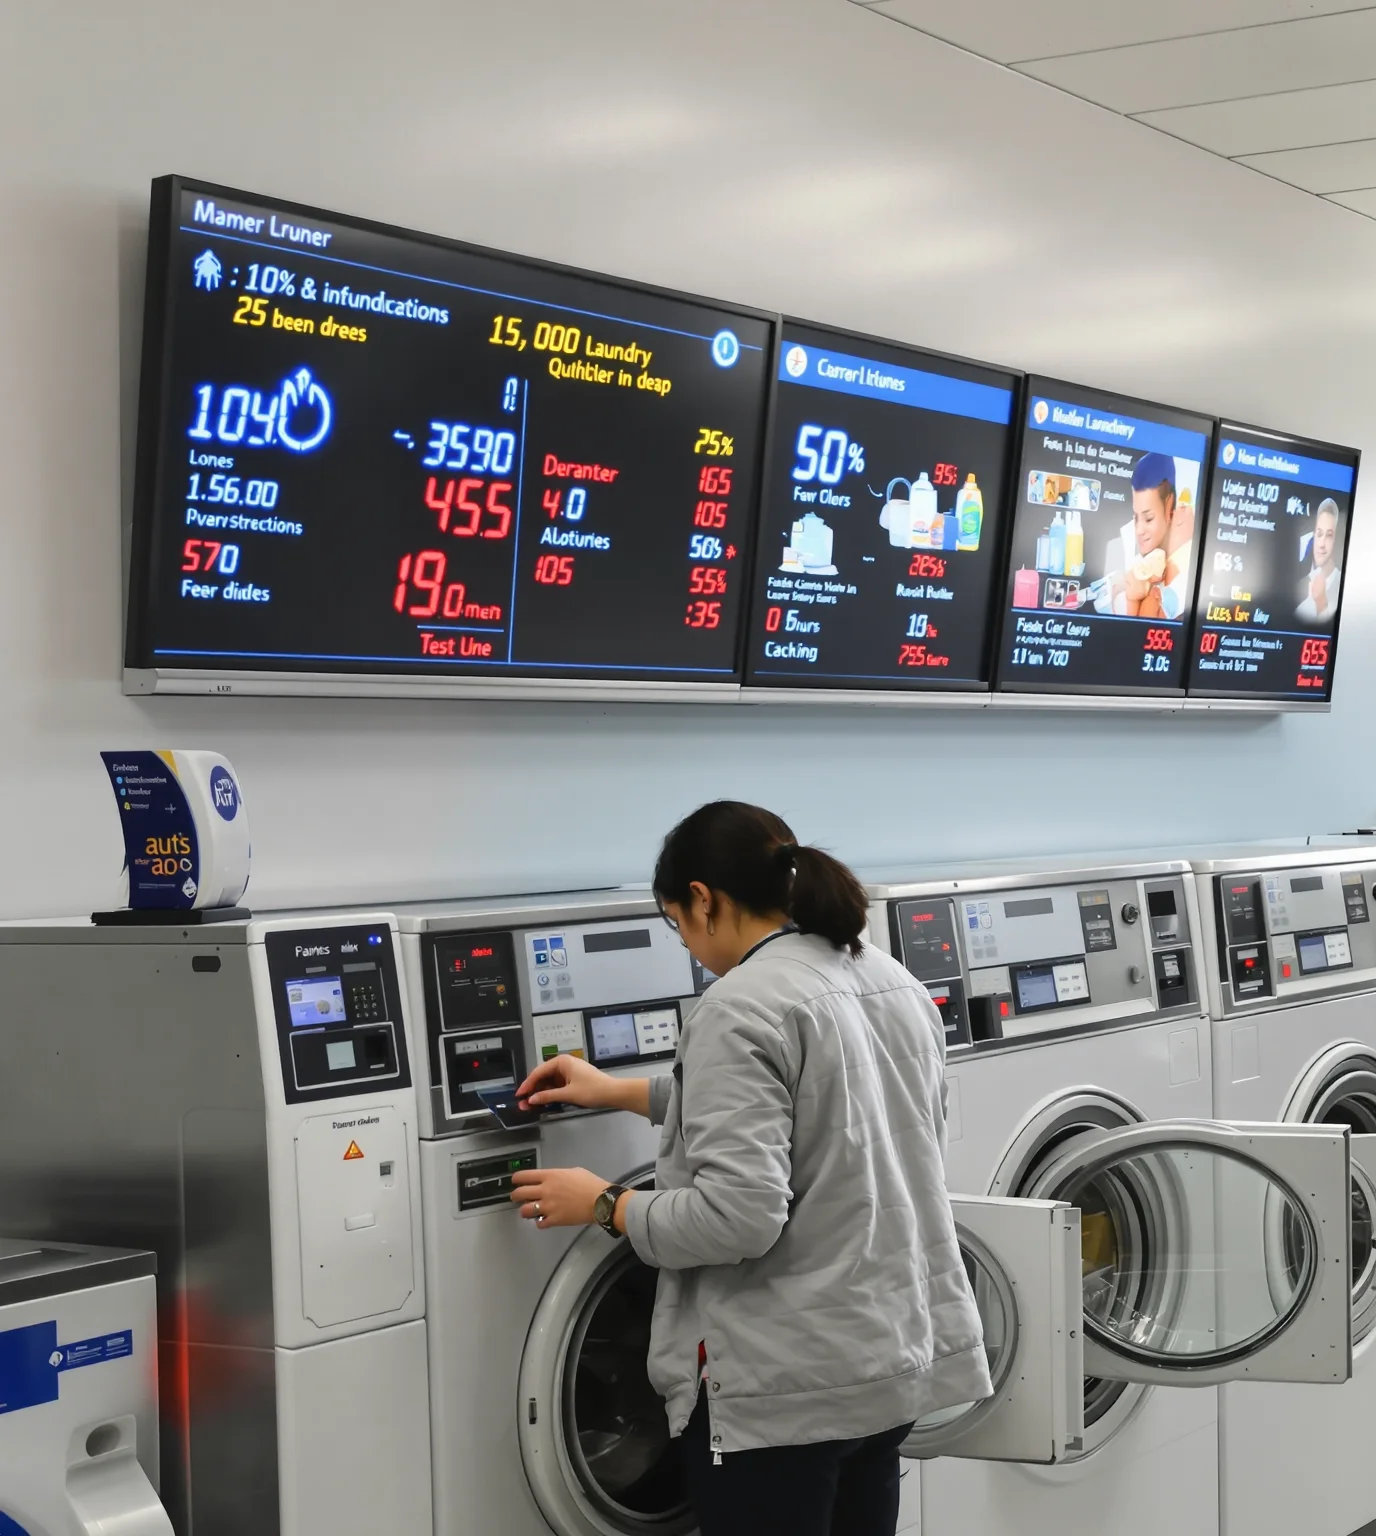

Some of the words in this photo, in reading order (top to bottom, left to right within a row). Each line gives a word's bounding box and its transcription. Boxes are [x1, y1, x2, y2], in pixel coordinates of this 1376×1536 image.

[244, 263, 295, 296] 10%
[301, 277, 317, 301] &
[233, 295, 269, 326] 25
[272, 308, 314, 334] been
[320, 315, 367, 342] drees
[586, 335, 652, 368] Laundry
[618, 369, 632, 387] in
[637, 373, 672, 396] deap
[189, 450, 234, 469] Lones
[543, 453, 620, 484] Deranter
[792, 423, 865, 484] 50%
[694, 500, 728, 529] 105
[182, 539, 240, 574] 570
[534, 555, 575, 586] 105
[420, 633, 455, 656] Test
